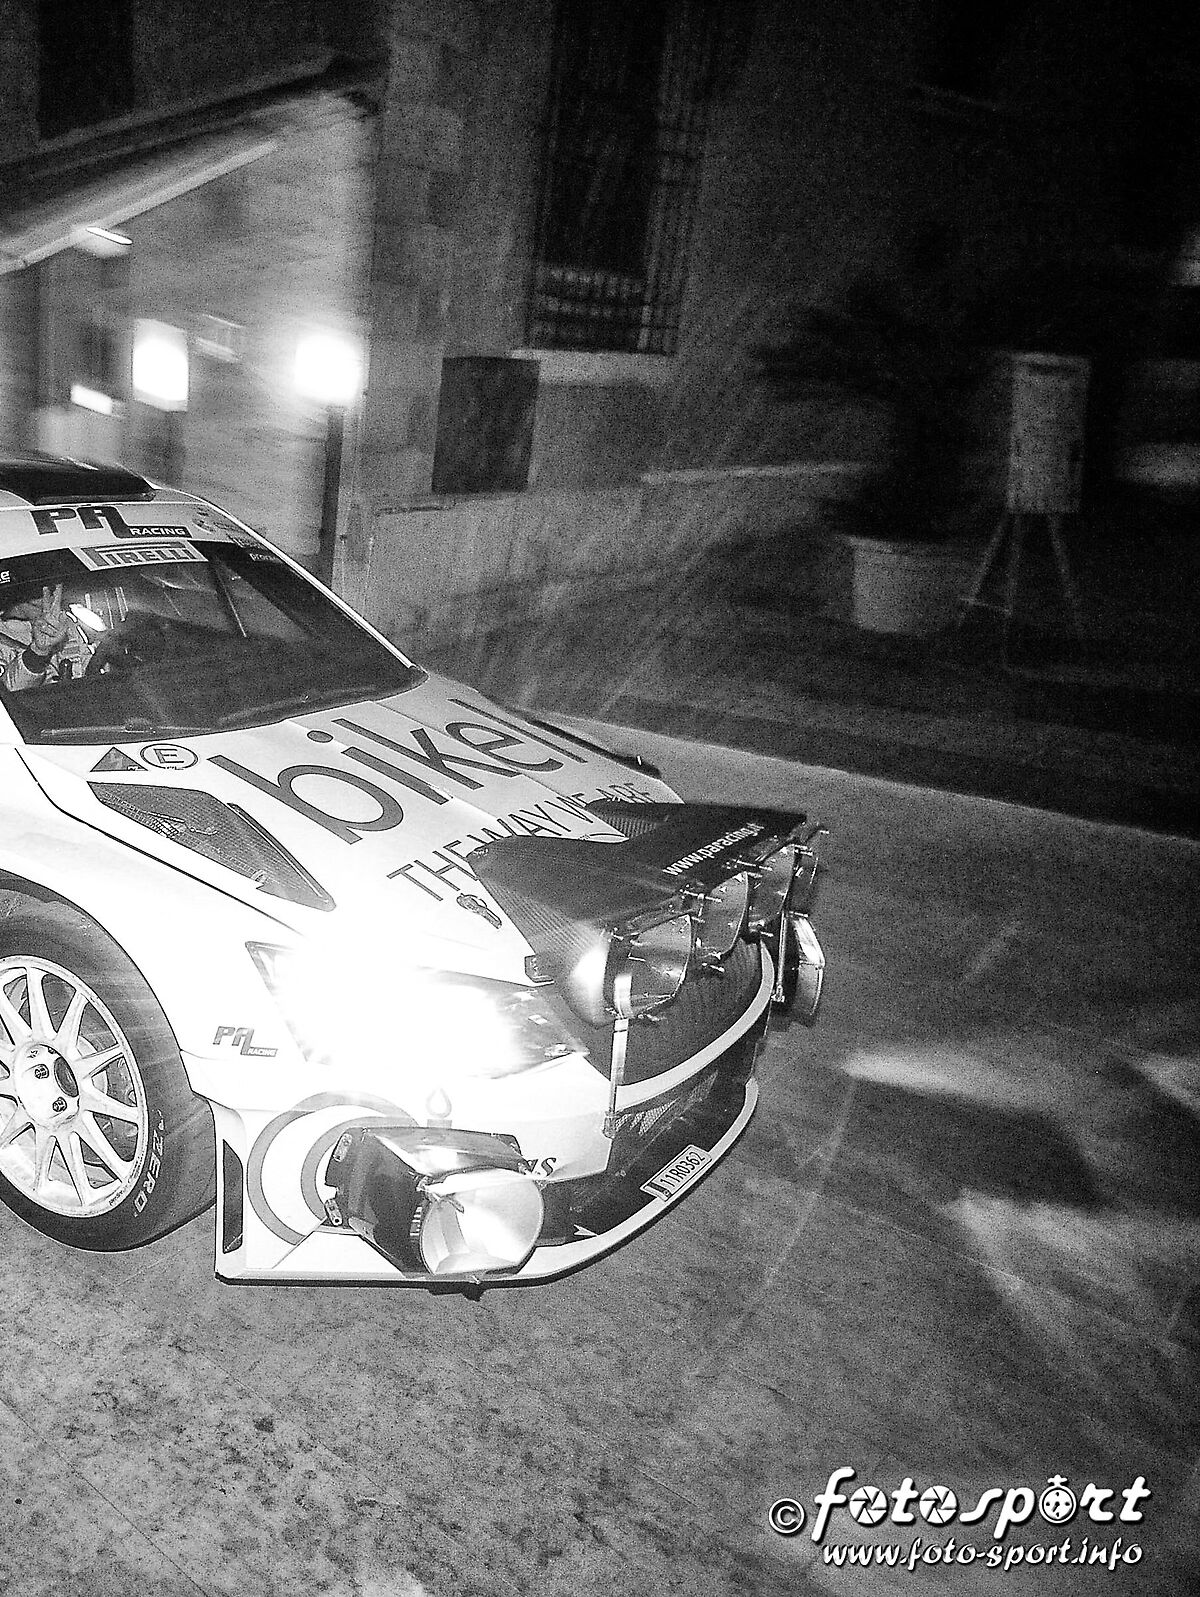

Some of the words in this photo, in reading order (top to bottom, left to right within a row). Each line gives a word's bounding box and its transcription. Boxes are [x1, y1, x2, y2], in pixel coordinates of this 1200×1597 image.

[129, 526, 186, 536] RACING
[80, 541, 198, 568] PIRELLI
[208, 697, 589, 846] bikel
[661, 821, 765, 877] www.paracing.it
[660, 1150, 706, 1188] 11R0362
